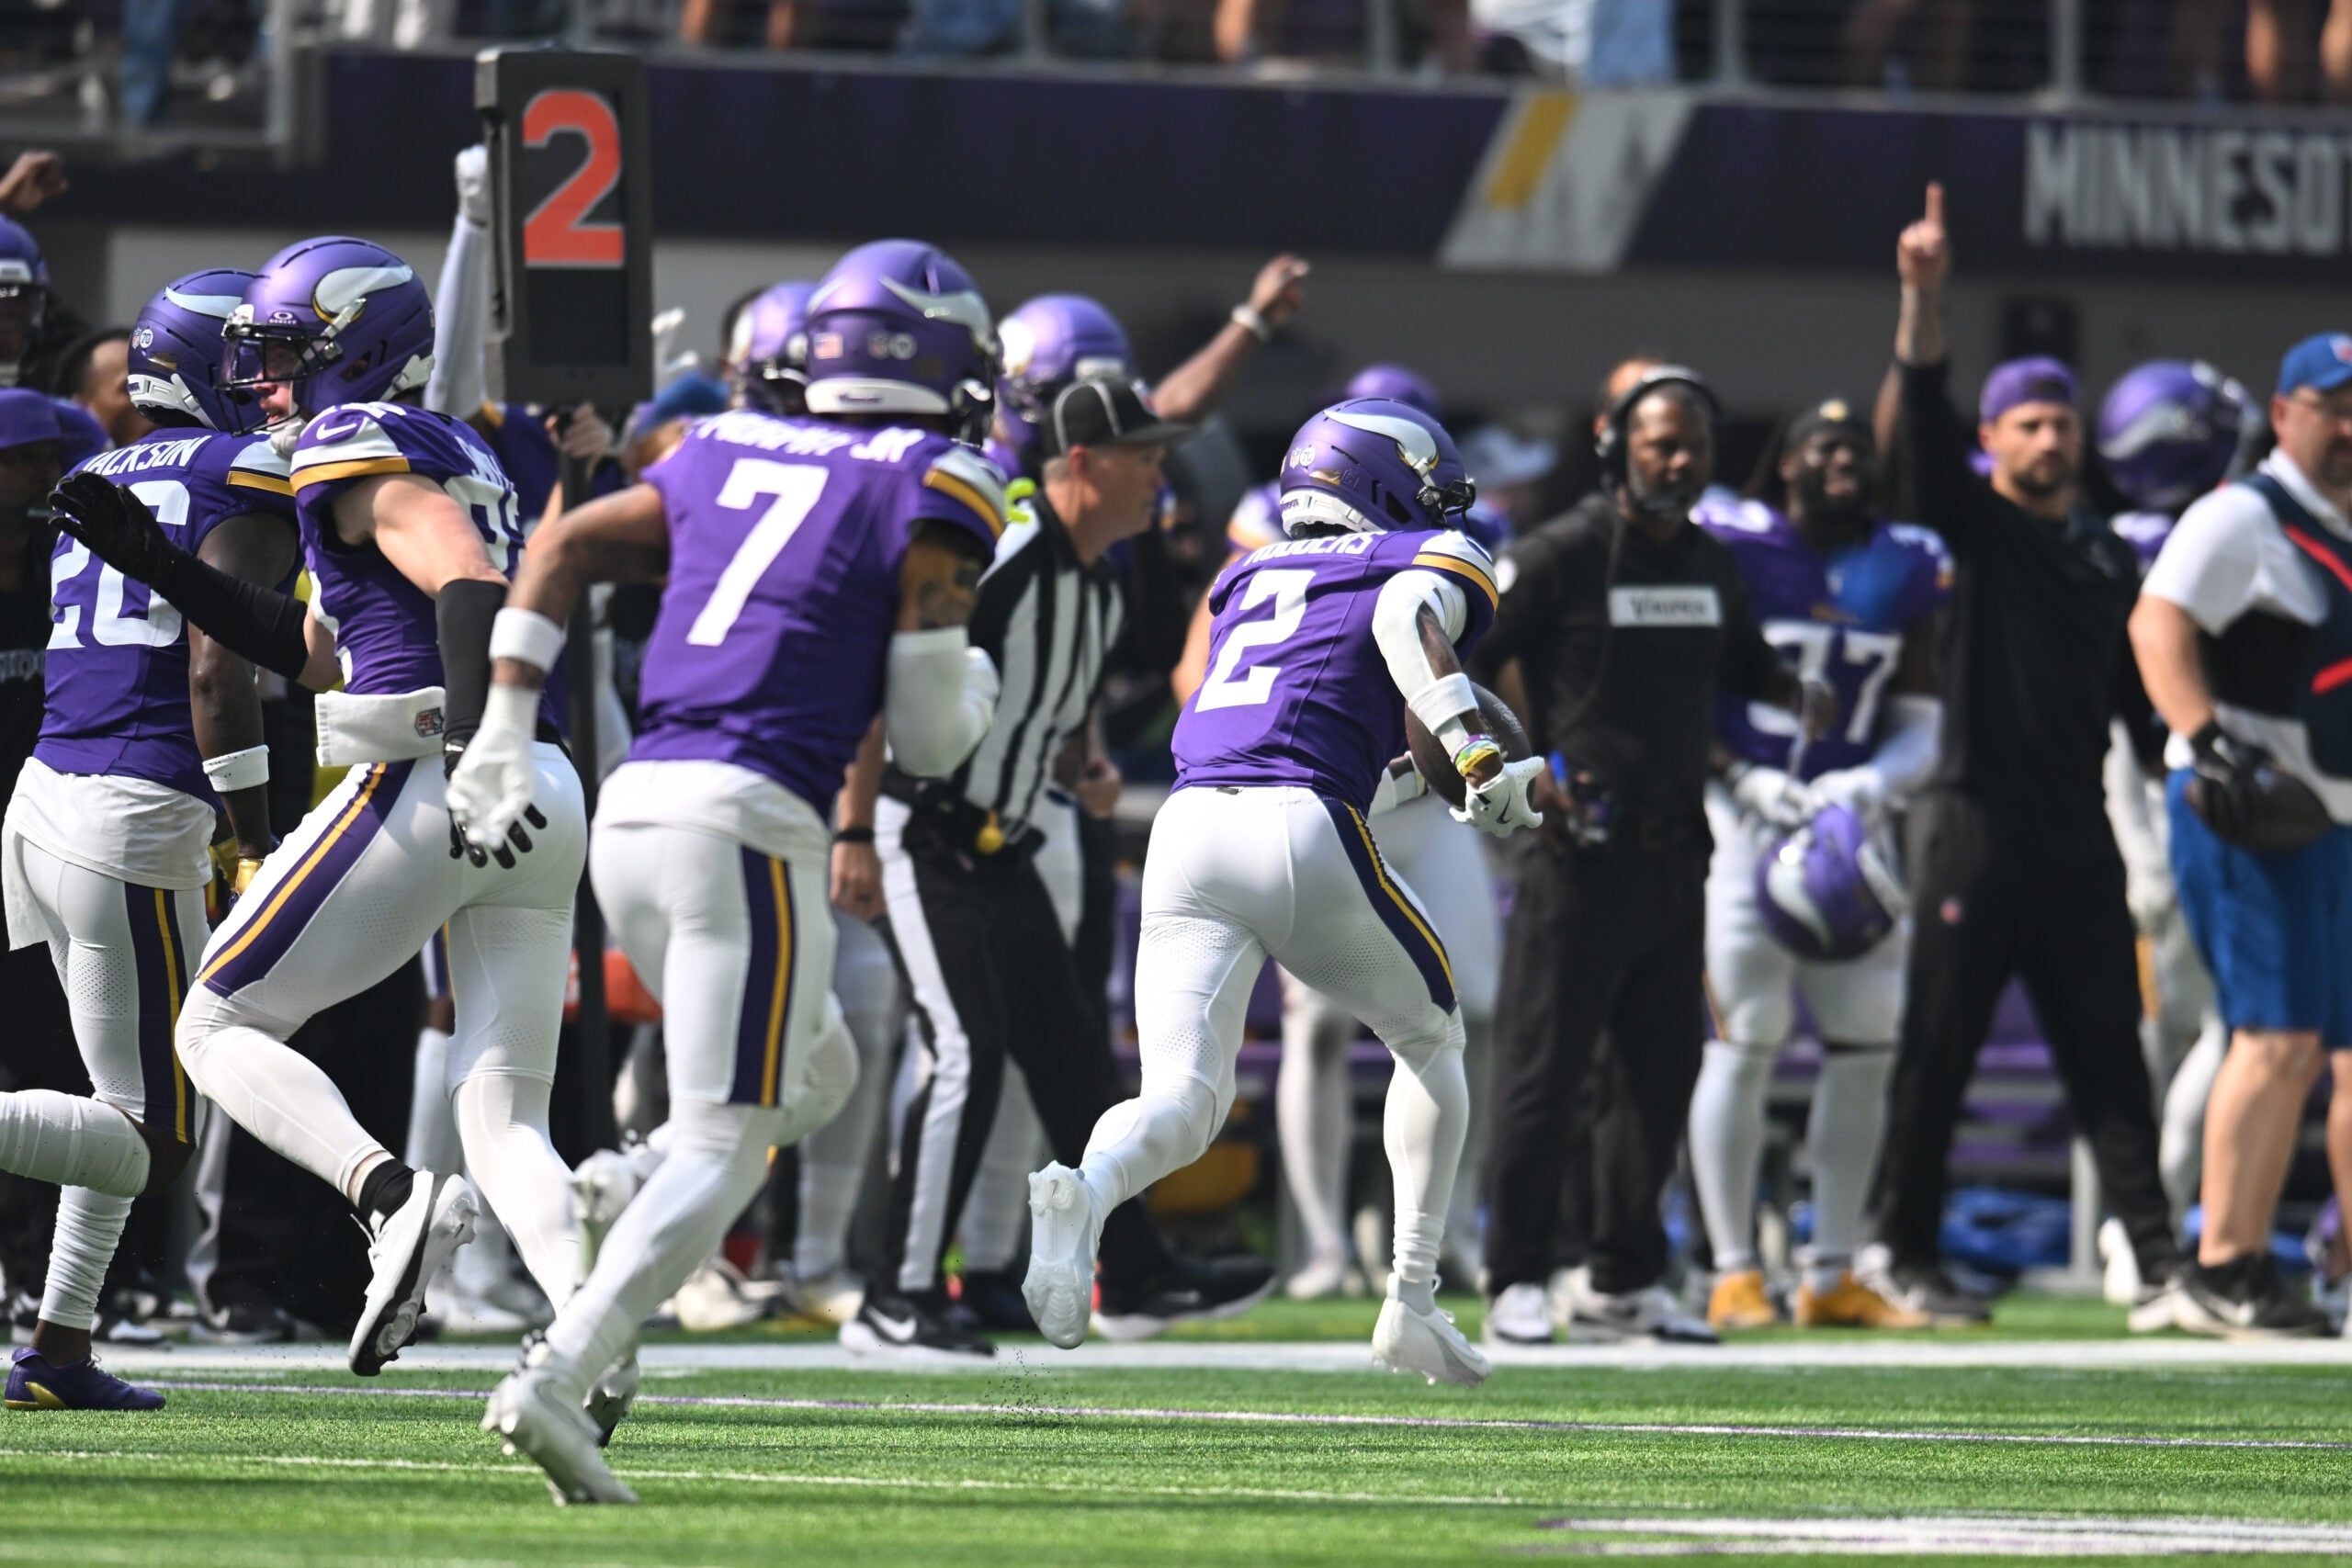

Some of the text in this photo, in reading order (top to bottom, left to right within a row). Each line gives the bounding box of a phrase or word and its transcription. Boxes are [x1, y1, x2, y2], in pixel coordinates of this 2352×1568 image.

[523, 90, 624, 267] 2
[2025, 125, 2352, 255] MINNESO
[686, 458, 829, 646] 7
[1194, 569, 1316, 714] 2
